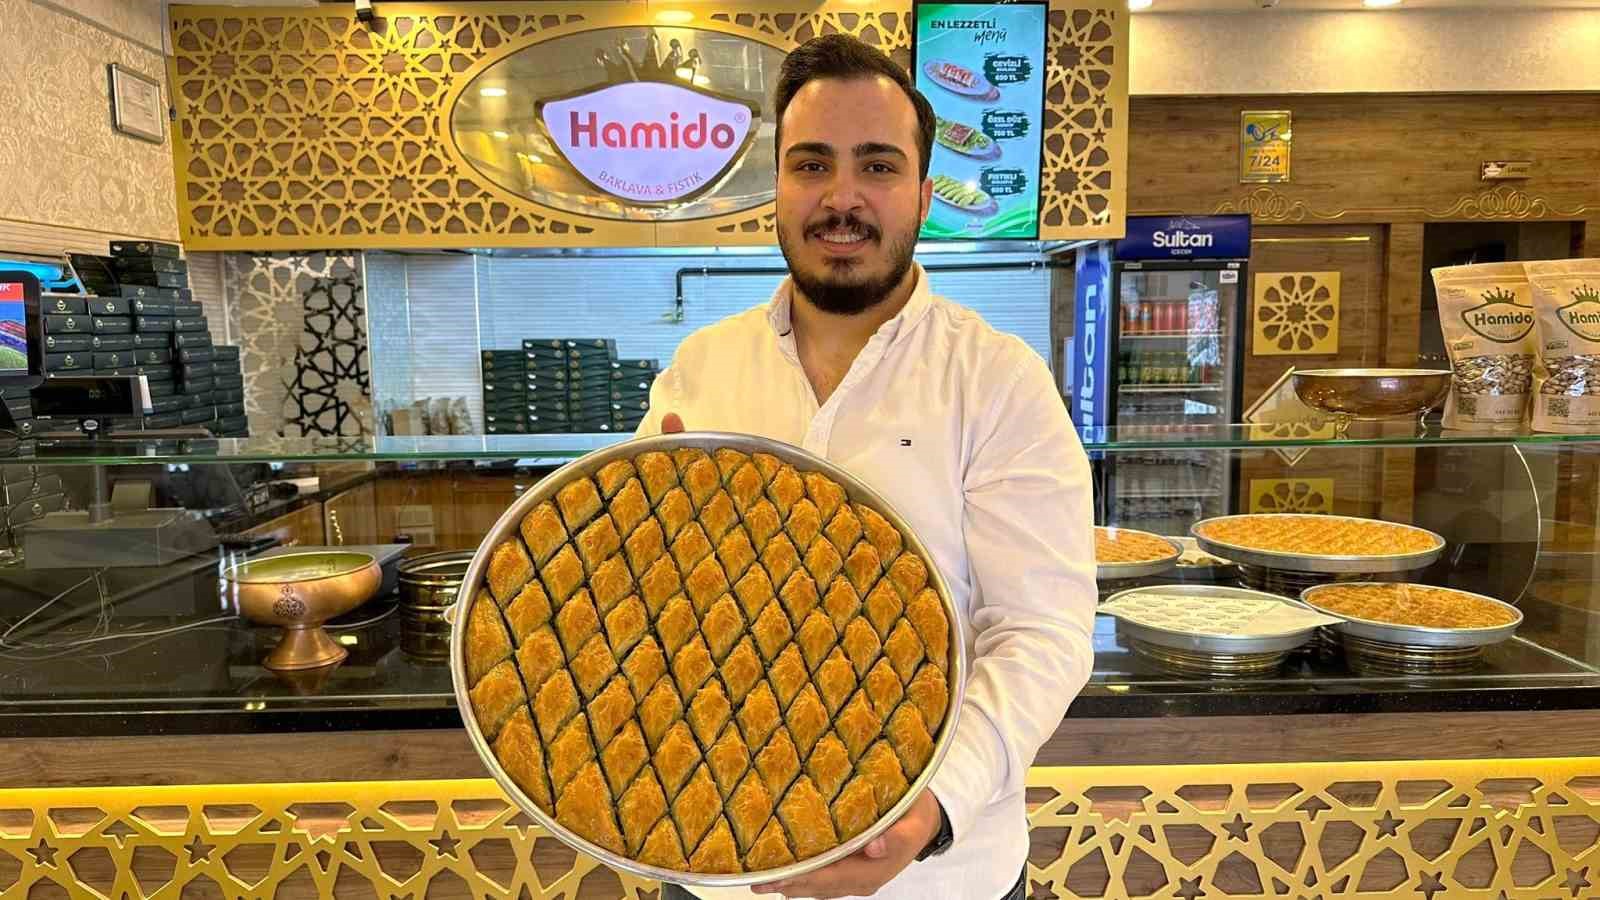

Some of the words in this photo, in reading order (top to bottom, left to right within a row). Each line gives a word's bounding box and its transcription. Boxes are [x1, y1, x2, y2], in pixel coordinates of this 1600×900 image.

[930, 20, 945, 29] EN
[947, 17, 996, 29] LEZZETLİ
[569, 111, 735, 149] Hamido
[1248, 154, 1280, 168] 7/24
[598, 170, 653, 196] BAKLAVA
[655, 184, 665, 195] &
[1152, 230, 1213, 248] Sultan
[1474, 311, 1532, 327] Hamido
[1080, 284, 1097, 444] ultan
